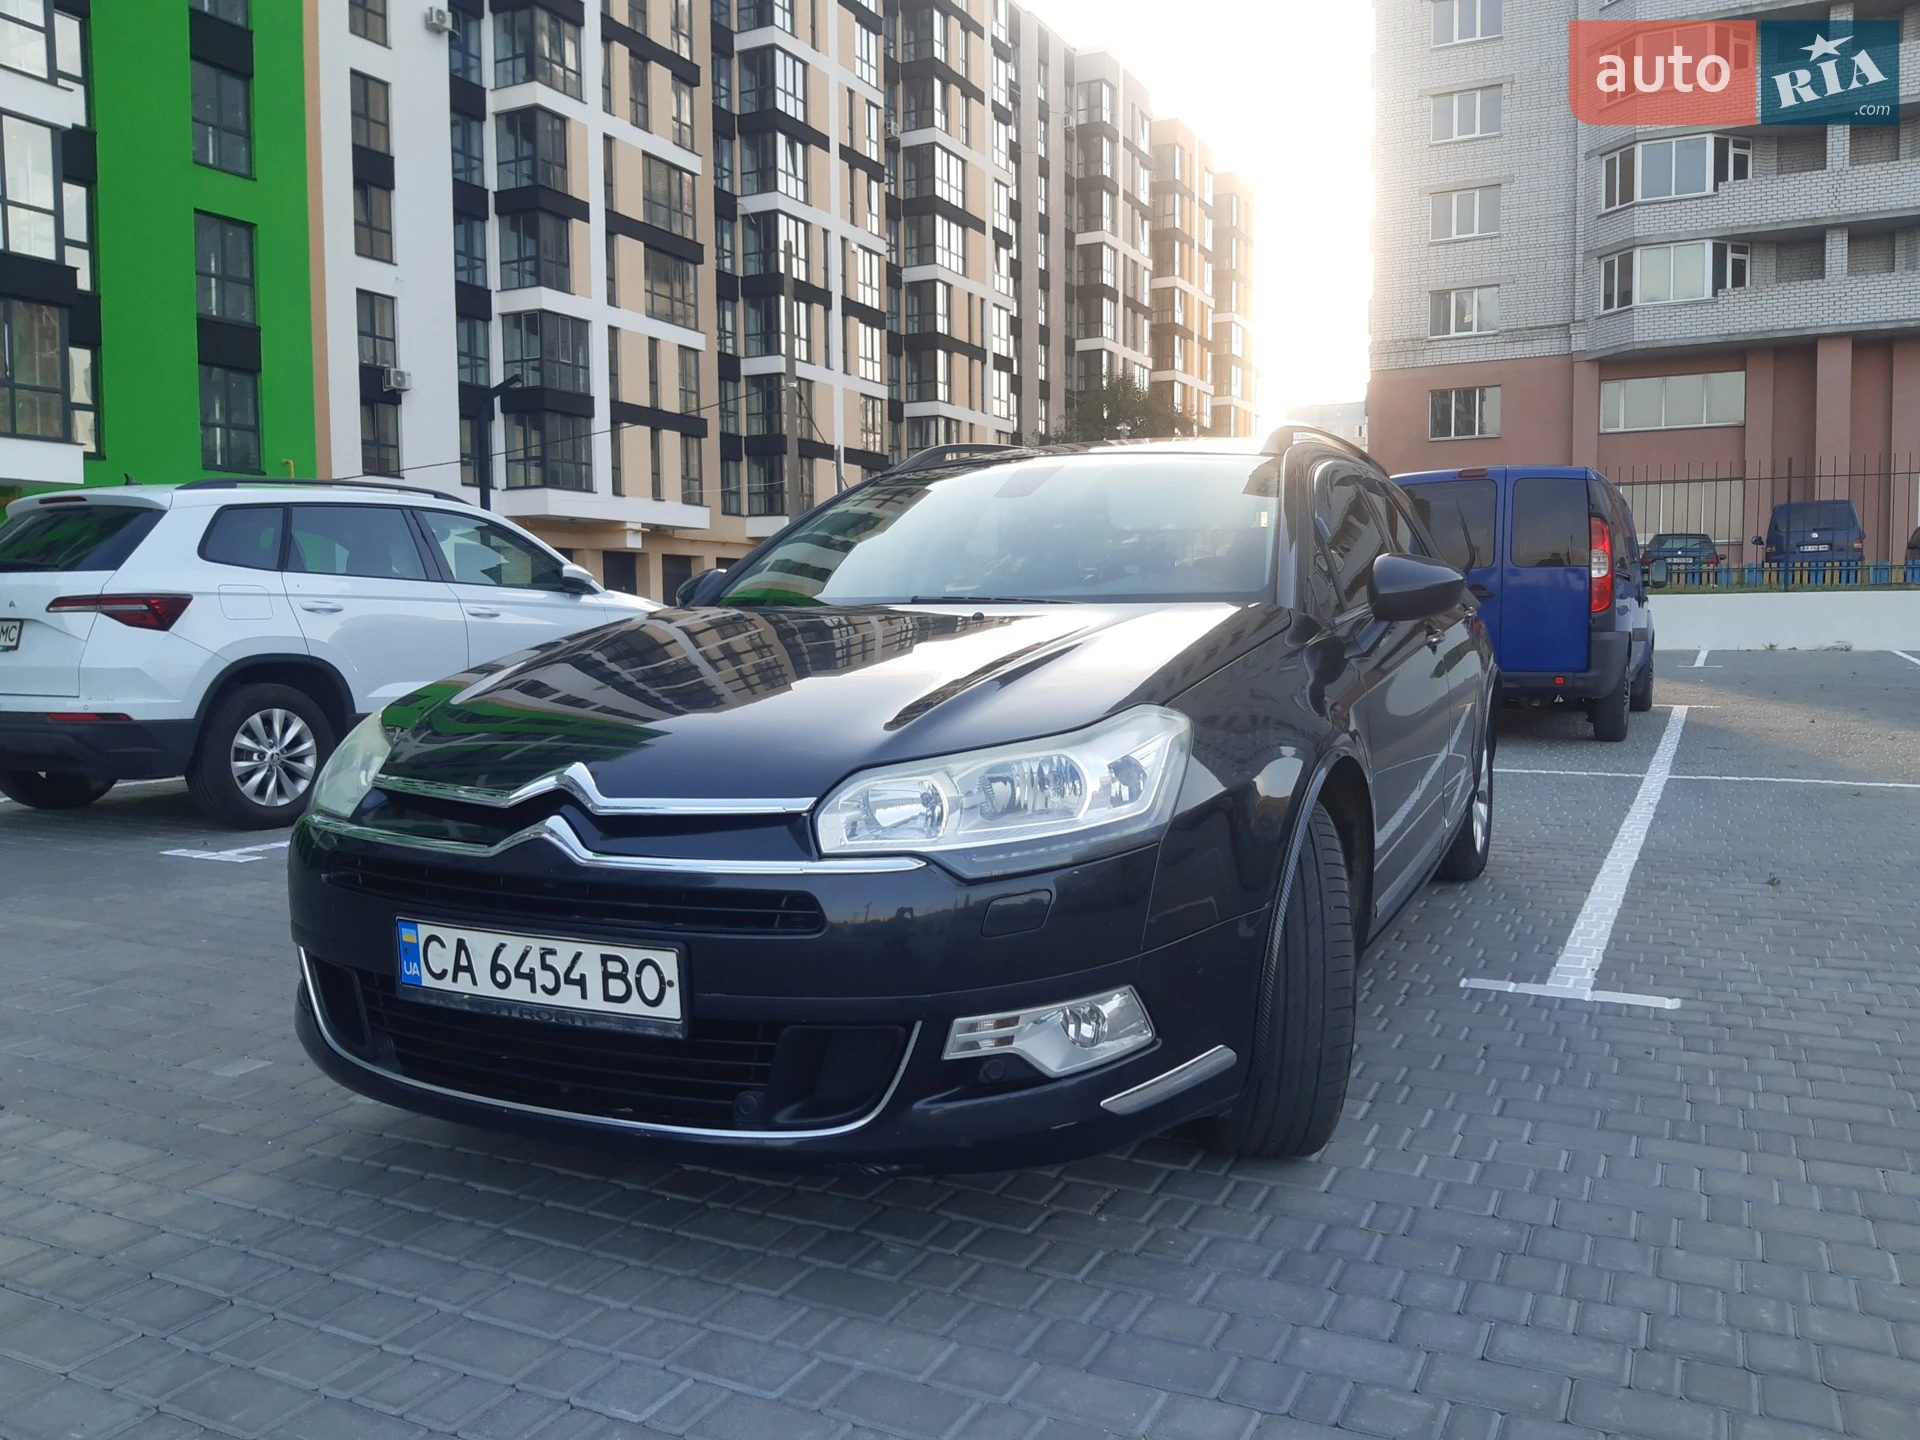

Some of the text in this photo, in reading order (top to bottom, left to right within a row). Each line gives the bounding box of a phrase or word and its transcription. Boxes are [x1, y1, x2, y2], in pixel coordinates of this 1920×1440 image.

[403, 960, 420, 977] UA
[422, 933, 668, 1008] CA 6454 BO
